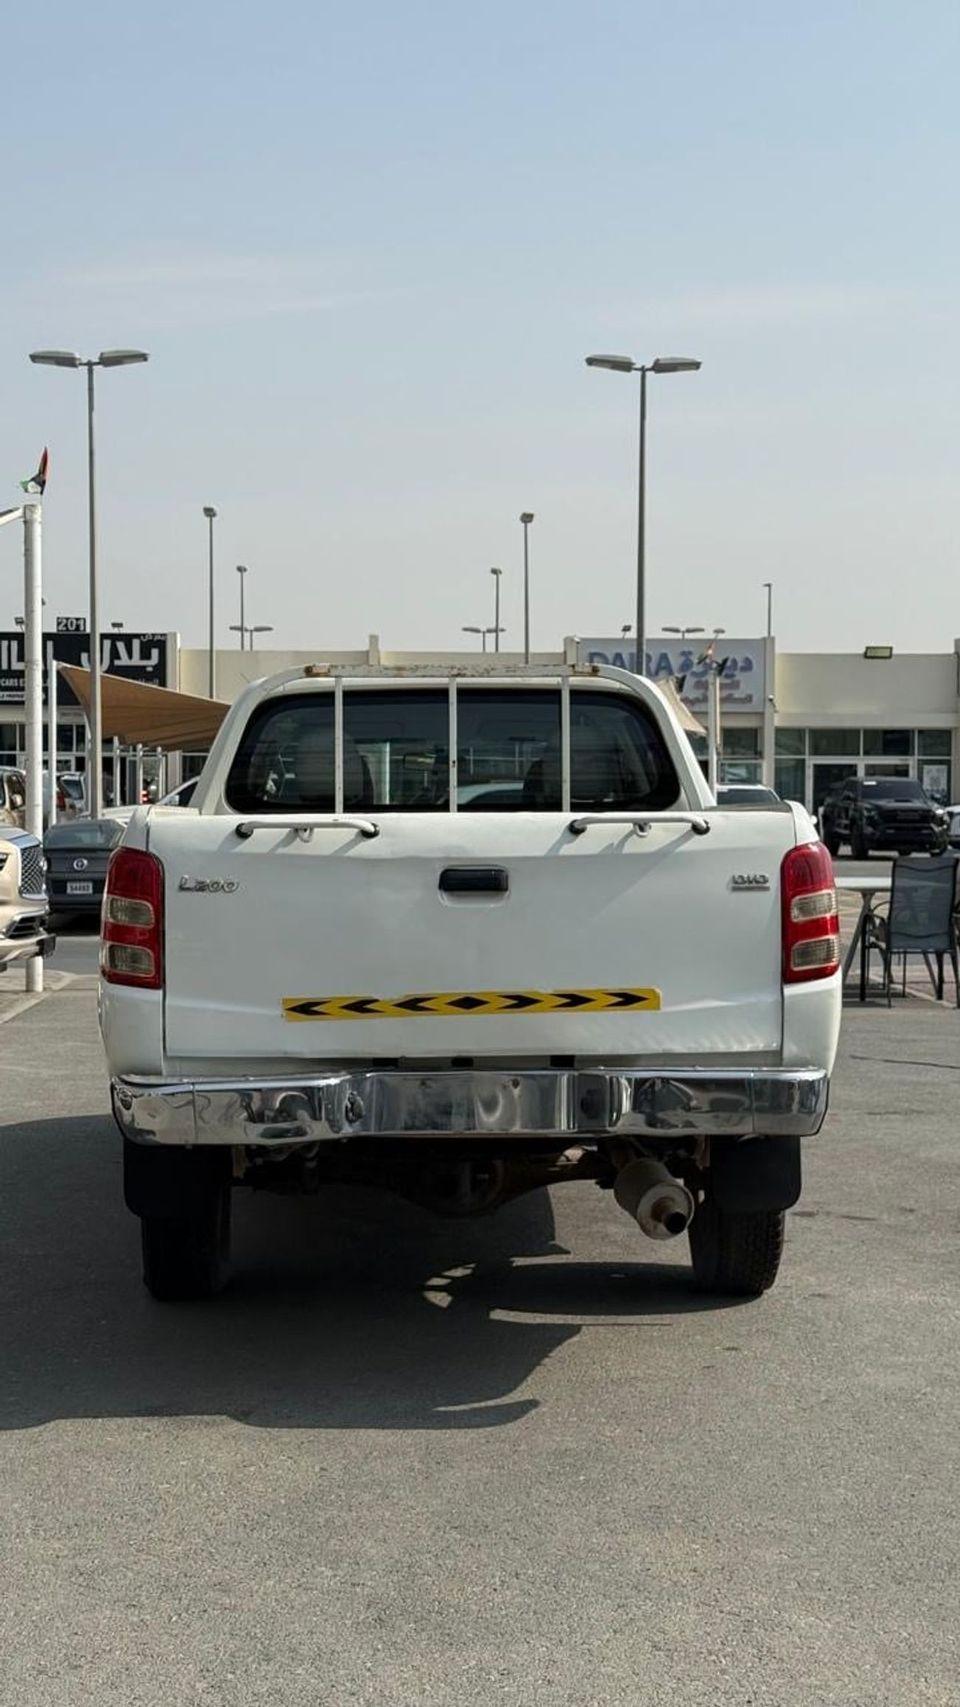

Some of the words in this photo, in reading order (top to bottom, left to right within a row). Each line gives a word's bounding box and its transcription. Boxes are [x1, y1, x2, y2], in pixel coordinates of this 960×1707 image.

[58, 618, 84, 630] 201
[81, 639, 158, 672] بلال
[179, 876, 239, 893] L200
